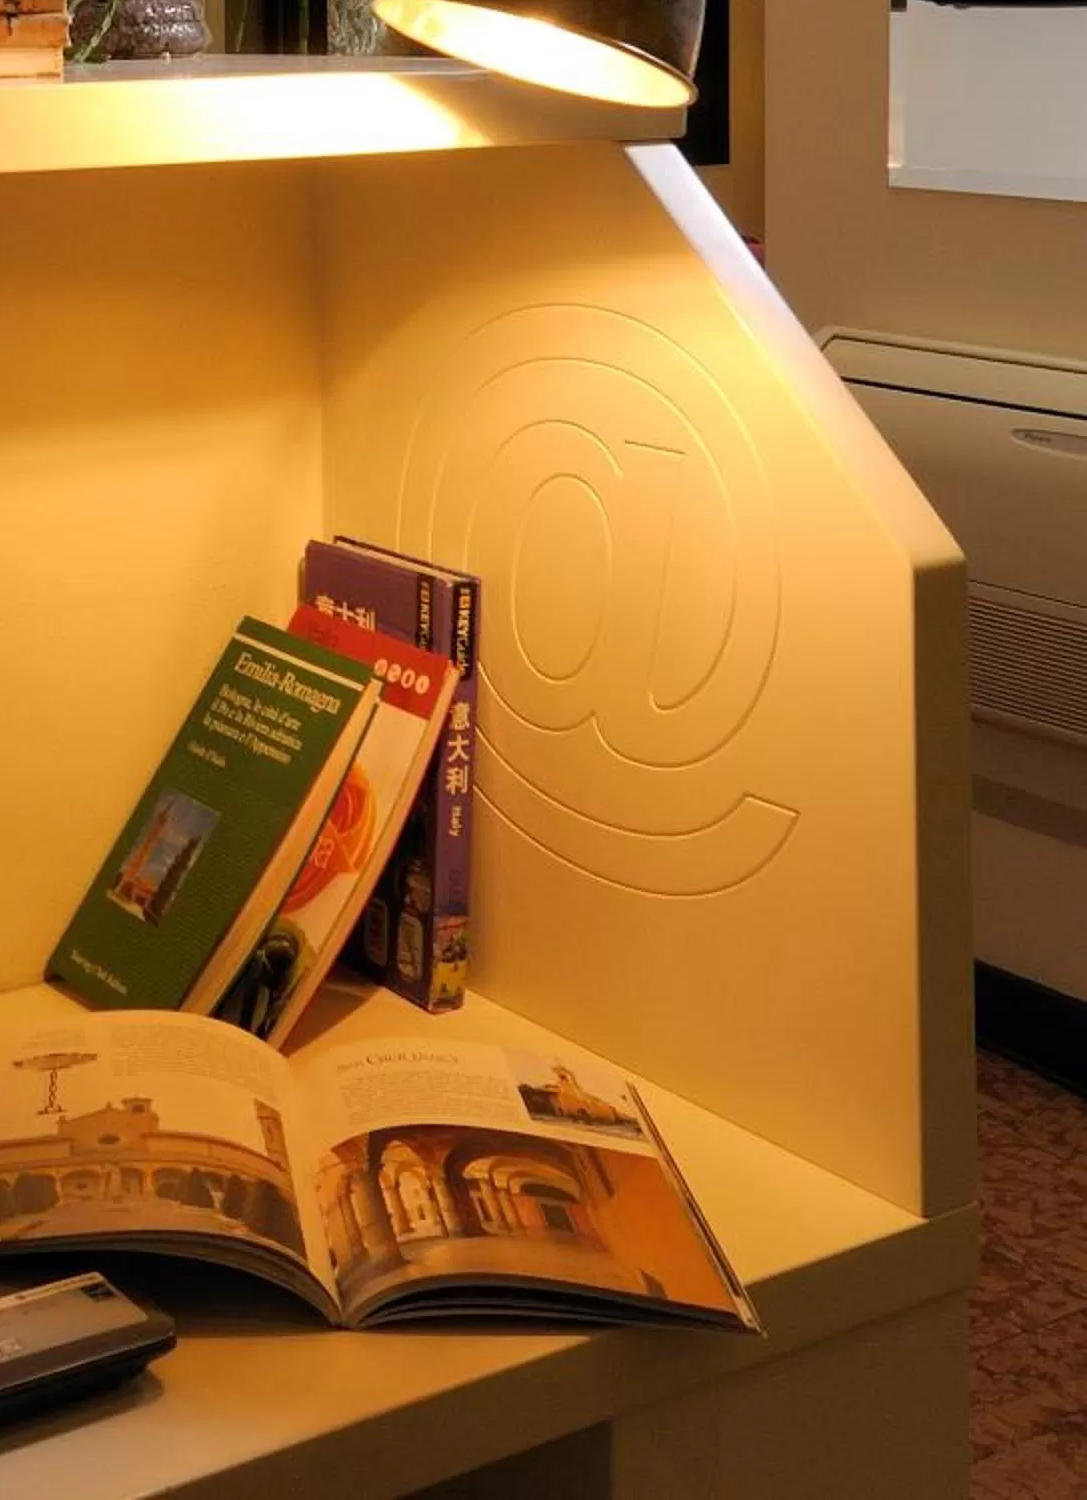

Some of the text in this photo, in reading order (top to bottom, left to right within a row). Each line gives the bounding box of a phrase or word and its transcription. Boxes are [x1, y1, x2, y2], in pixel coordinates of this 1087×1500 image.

[234, 651, 341, 715] Emilia-Romagna
[446, 701, 470, 796] 意大利
[448, 803, 463, 838] Italy
